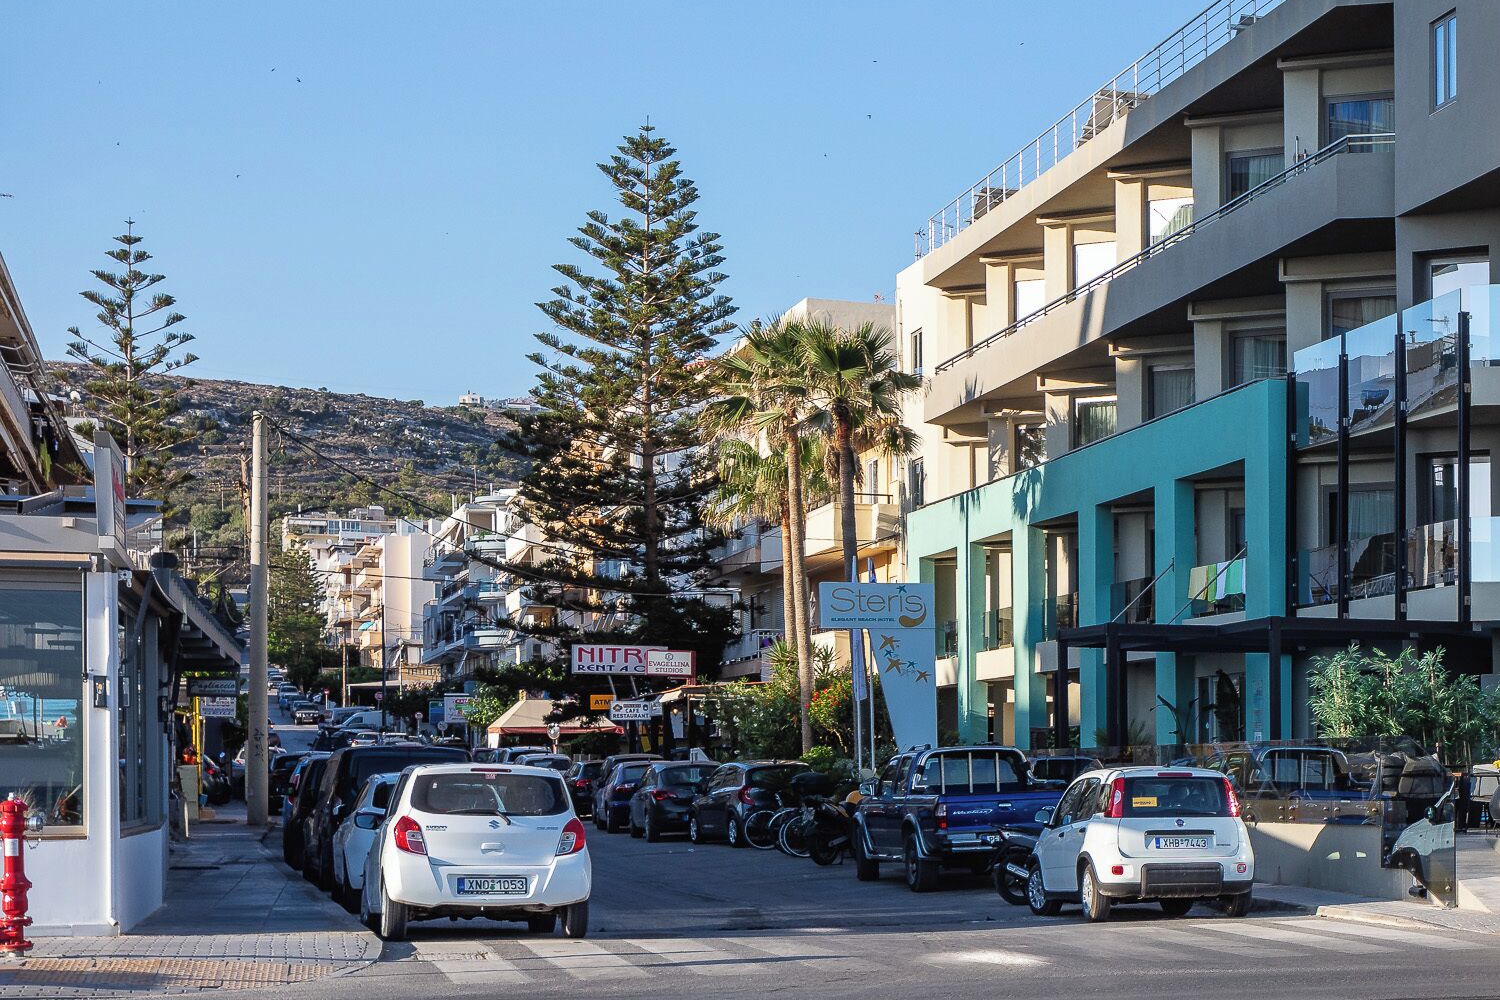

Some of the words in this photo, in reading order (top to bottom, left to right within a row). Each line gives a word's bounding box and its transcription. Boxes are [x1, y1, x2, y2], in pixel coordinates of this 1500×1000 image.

[831, 585, 925, 613] Steris
[577, 647, 650, 663] NITR
[577, 664, 615, 672] RENT
[620, 664, 629, 672] A
[648, 660, 690, 668] EVAGELLINA
